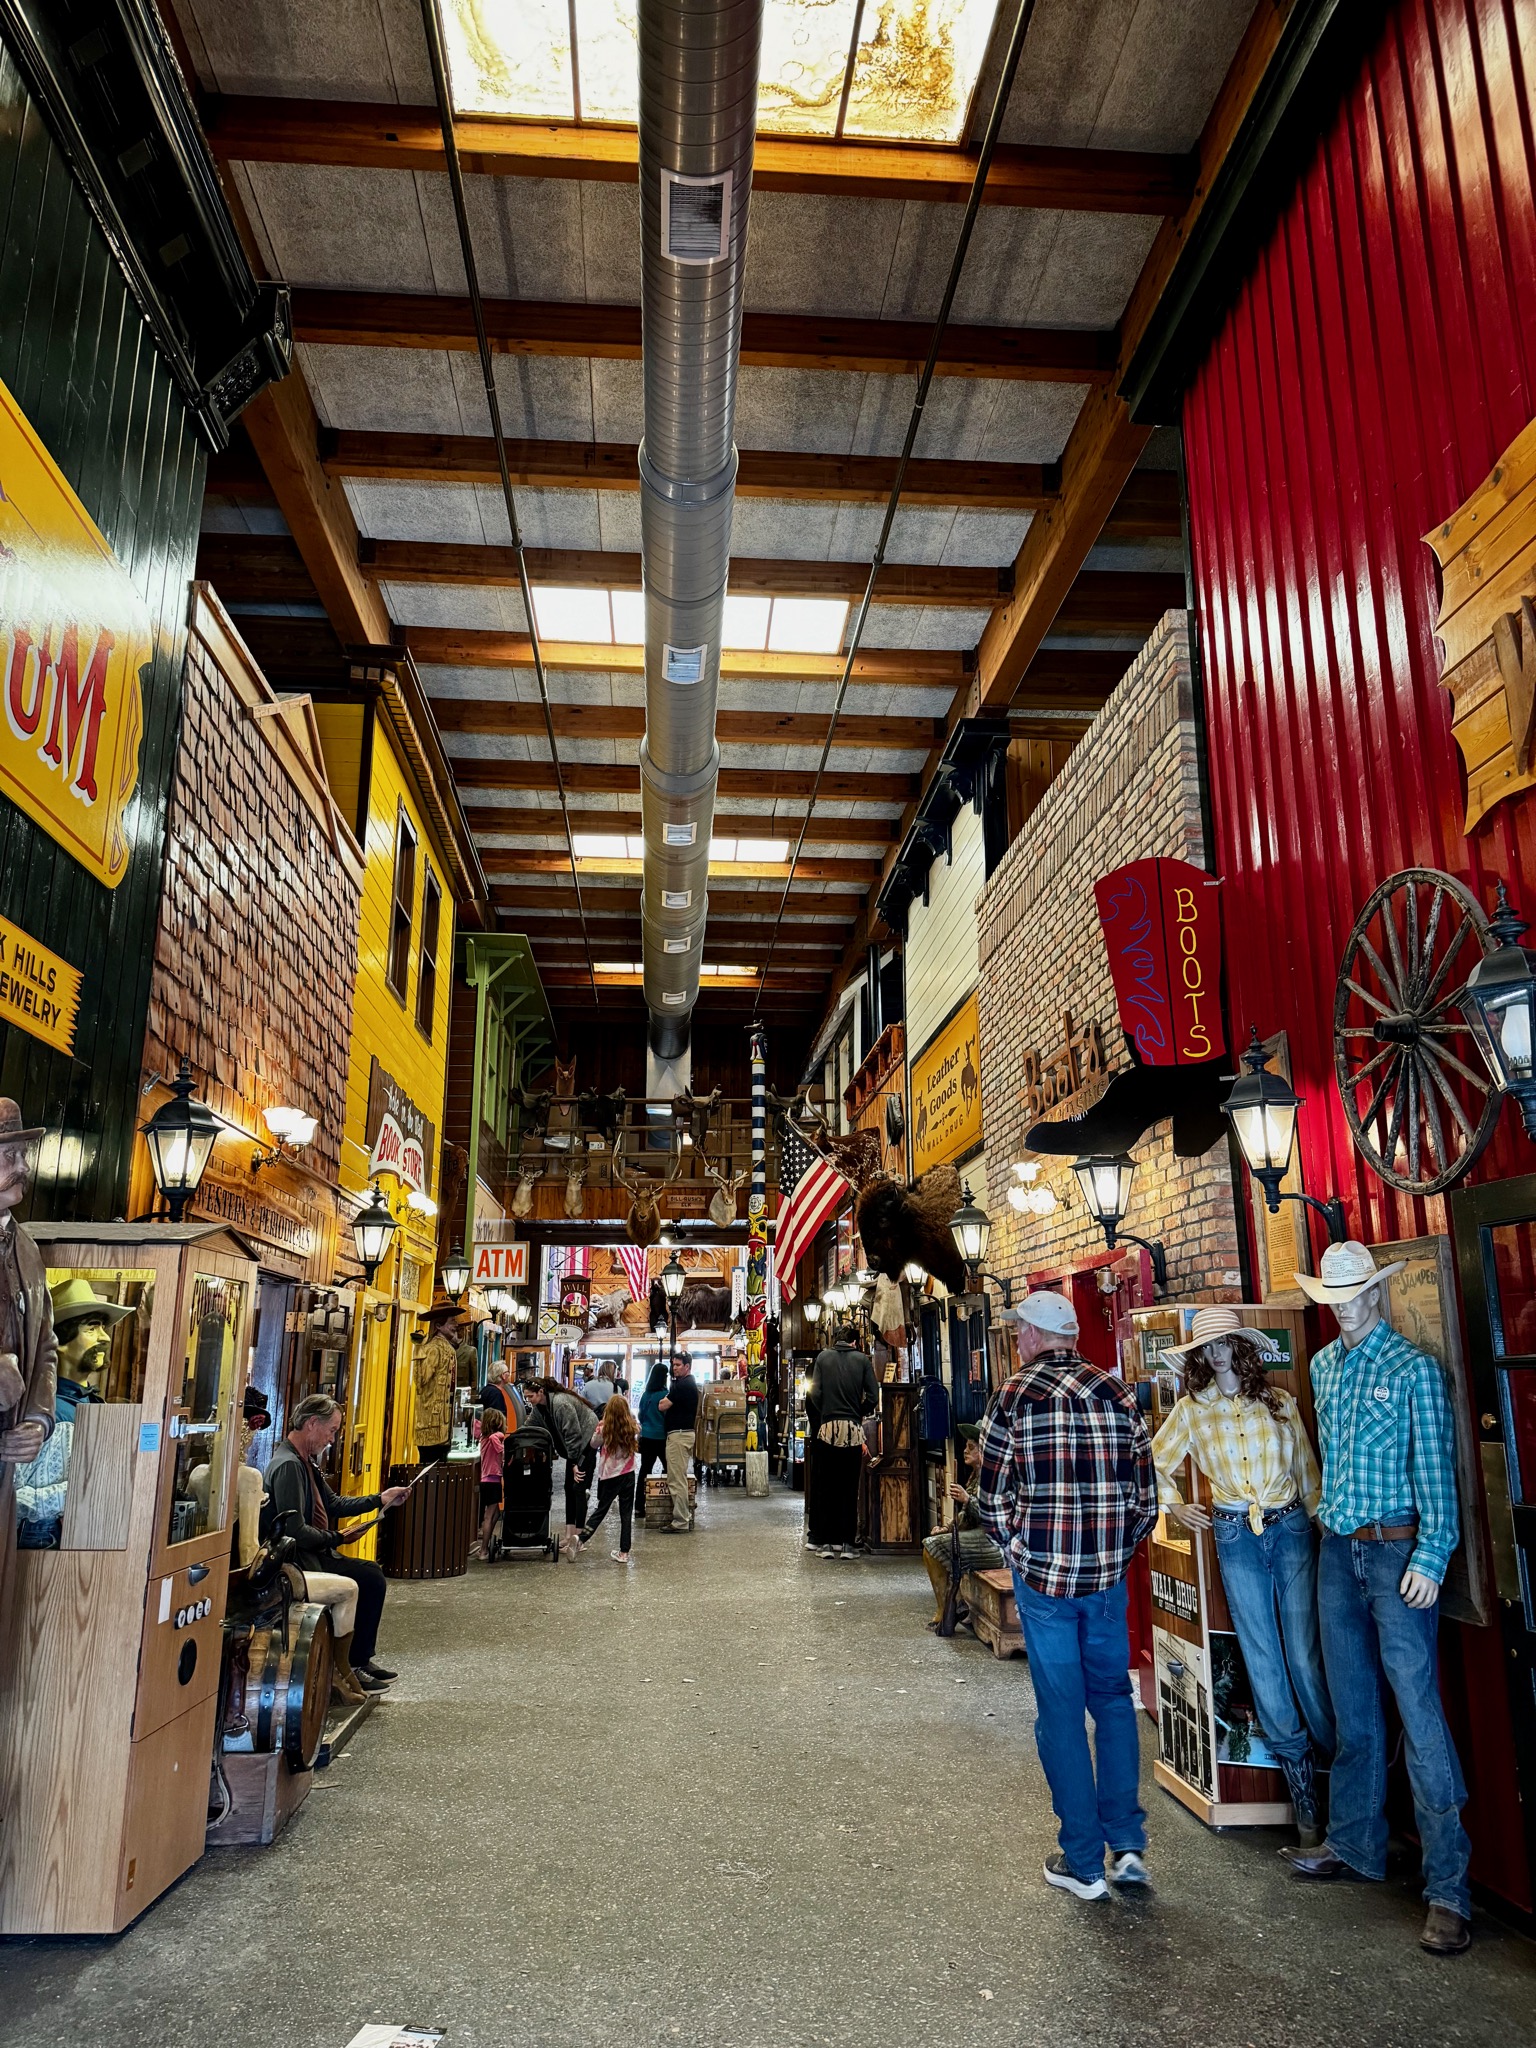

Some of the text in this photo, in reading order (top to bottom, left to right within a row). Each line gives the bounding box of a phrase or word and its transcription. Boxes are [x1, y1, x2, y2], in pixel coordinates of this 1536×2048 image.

[13, 943, 57, 994] HILLS
[1174, 887, 1211, 1058] BOOTS
[927, 1046, 960, 1095] Leather
[929, 1077, 958, 1116] Goods
[377, 1123, 401, 1166] BOOK
[402, 1147, 423, 1188] STORE
[927, 1113, 964, 1153] WALL DRUG
[197, 1181, 247, 1226] WESTERN
[258, 1206, 311, 1252] PERIODICALS
[476, 1249, 523, 1278] ATM
[564, 1283, 587, 1293] WALL
[1151, 1570, 1198, 1613] WALL DRUG
